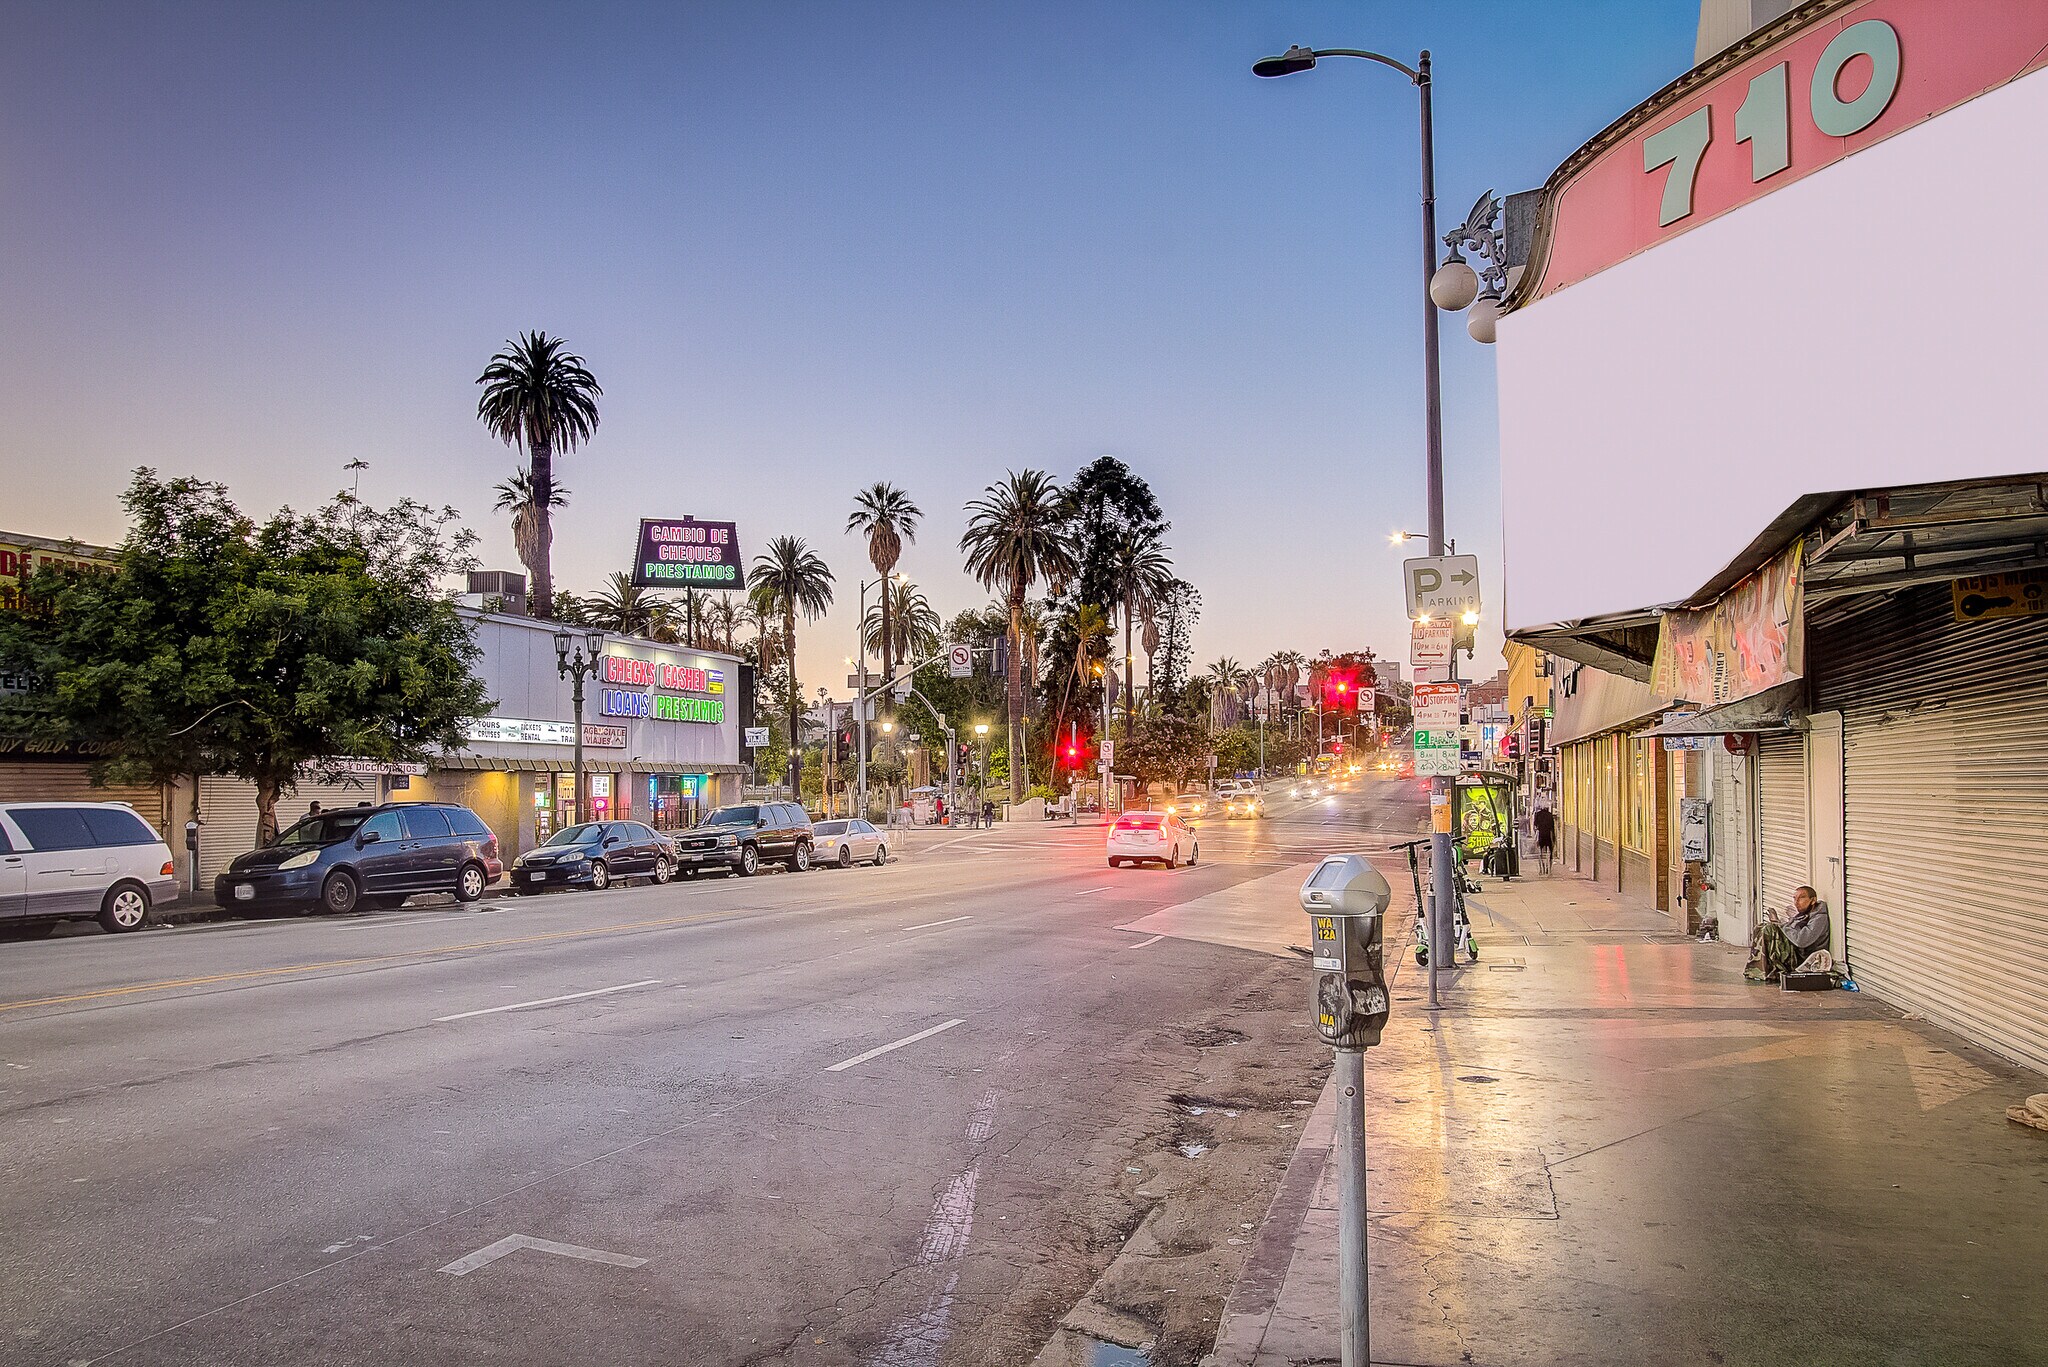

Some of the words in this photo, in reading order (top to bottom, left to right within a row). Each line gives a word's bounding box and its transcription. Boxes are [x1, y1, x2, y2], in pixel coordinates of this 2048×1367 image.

[1643, 19, 1902, 228] 710
[651, 525, 706, 544] CAMBIO
[710, 528, 729, 544] DE
[659, 545, 722, 563] CHEQUES
[645, 563, 735, 580] PRESTAMOS
[1425, 629, 1450, 638] PARKING
[606, 656, 656, 687] CHECKS
[663, 664, 706, 693] CASHED
[607, 689, 650, 718] LOANS
[656, 695, 725, 724] PRESTAMOS
[1415, 694, 1429, 707] NO
[1429, 695, 1458, 705] STOPPING
[1417, 711, 1432, 719] 4PM
[1442, 710, 1457, 718] 7PM
[477, 720, 501, 729] TOURS
[560, 725, 576, 734] HOTE
[478, 730, 501, 739] CRUISES
[520, 732, 541, 741] RENTAL
[561, 735, 576, 743] TRAI
[585, 736, 612, 746] VIAJES
[1417, 732, 1427, 744] 2
[0, 739, 22, 752] UY
[1318, 917, 1333, 929] WA
[1319, 929, 1336, 940] 12A
[1320, 1013, 1335, 1027] WA
